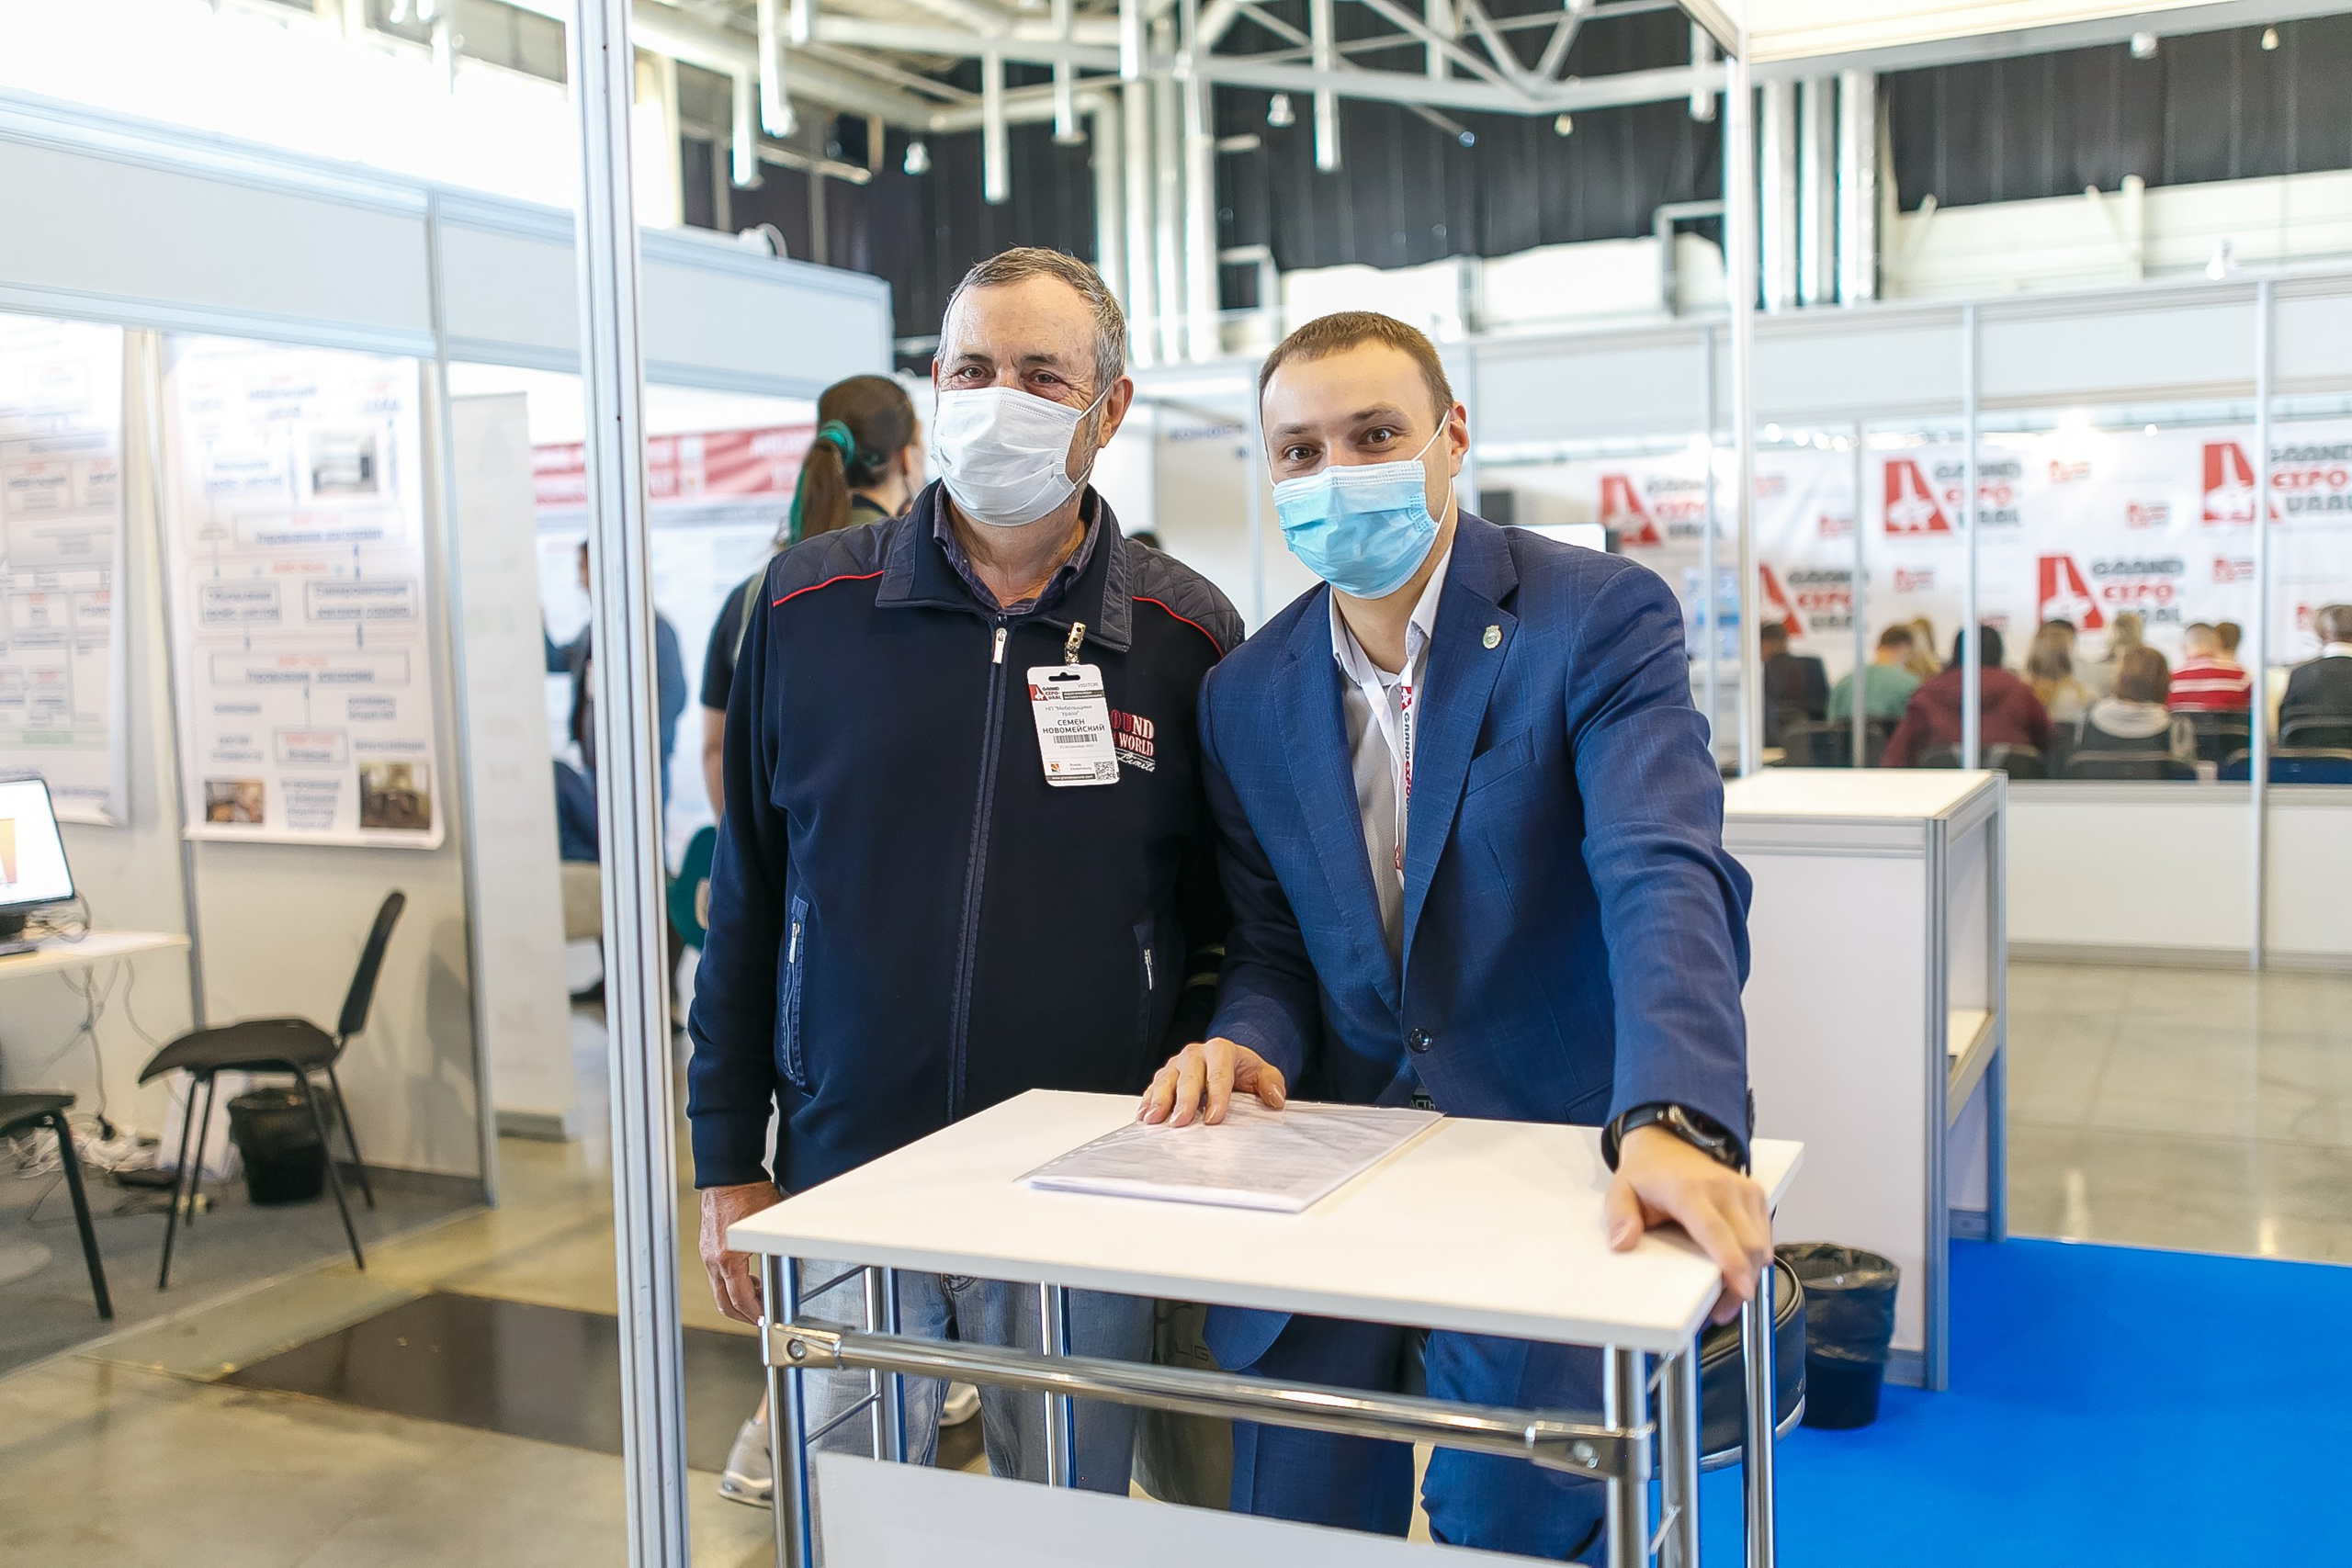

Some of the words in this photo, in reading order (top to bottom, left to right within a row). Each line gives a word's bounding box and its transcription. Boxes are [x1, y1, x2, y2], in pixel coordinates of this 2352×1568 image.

[1042, 724, 1105, 734] НОВОМЕЙСКИЙ
[1057, 718, 1085, 727] СЕМЕН
[1111, 709, 1155, 739] OUND
[1119, 731, 1154, 757] WORLD
